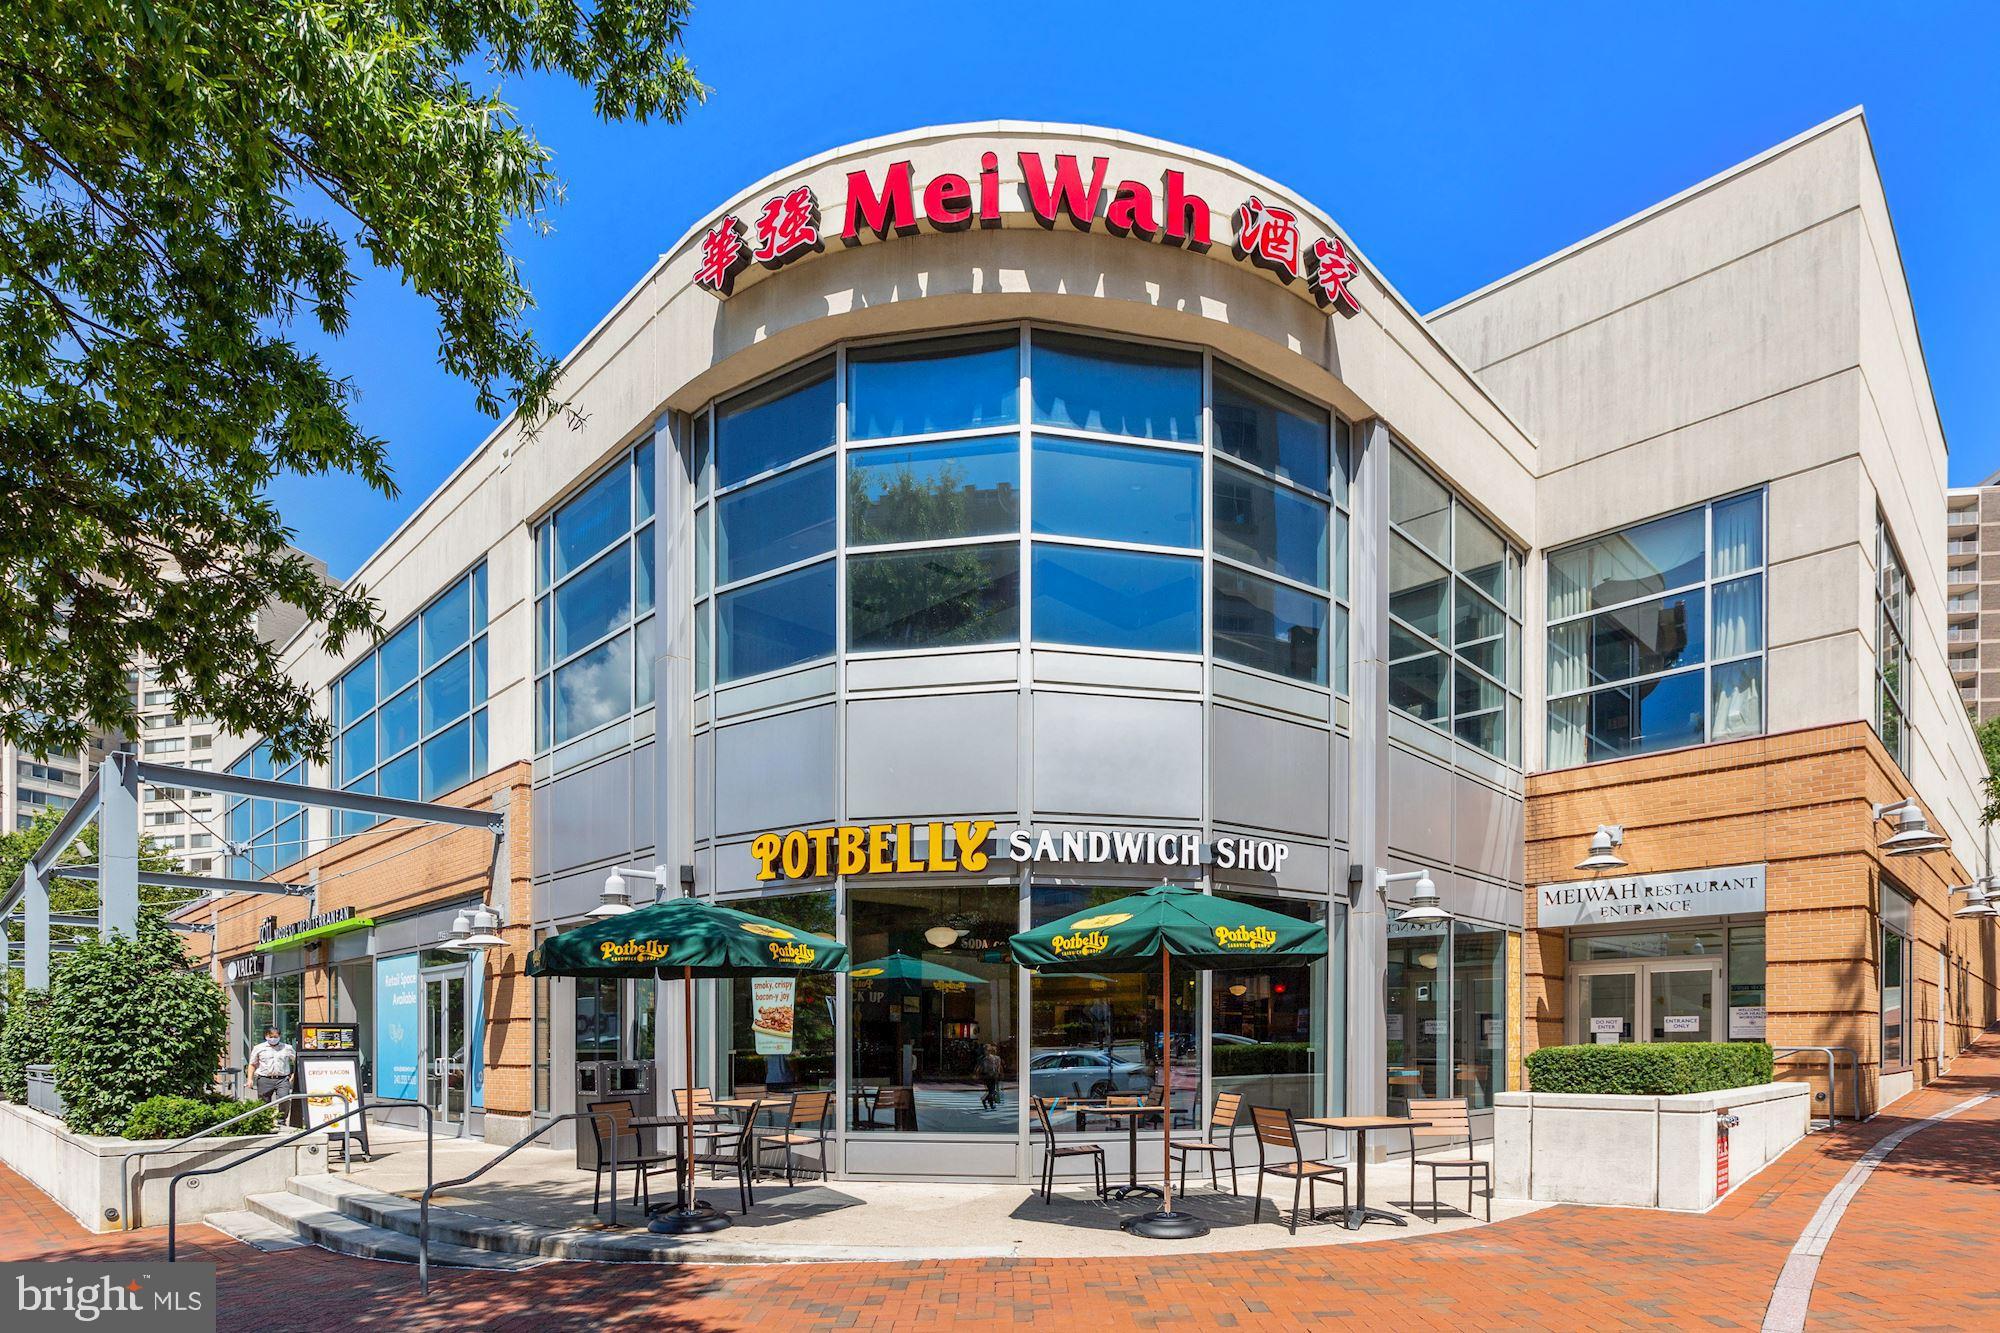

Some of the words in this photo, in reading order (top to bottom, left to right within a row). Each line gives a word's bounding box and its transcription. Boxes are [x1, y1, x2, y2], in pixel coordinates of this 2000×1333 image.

[841, 151, 1000, 242] Mei
[1018, 152, 1213, 249] Wah
[1239, 195, 1362, 314] 酒家
[750, 820, 995, 882] POTBELLY
[1009, 830, 1200, 867] SANDWICH
[1216, 837, 1290, 873] SHOP
[1545, 883, 1638, 906] MEIWAH
[1645, 877, 1758, 898] RESTAURANT
[297, 907, 349, 934] MEDITERRANEAN
[1600, 900, 1691, 918] ENTRANCE
[961, 938, 989, 950] SODA
[1052, 931, 1109, 956] Potbelly
[1215, 925, 1277, 949] Potbelly
[600, 939, 669, 961] Potbelly
[768, 942, 815, 964] Potbelly
[400, 972, 416, 989] Space
[774, 981, 793, 990] crispy
[869, 991, 885, 1003] UP
